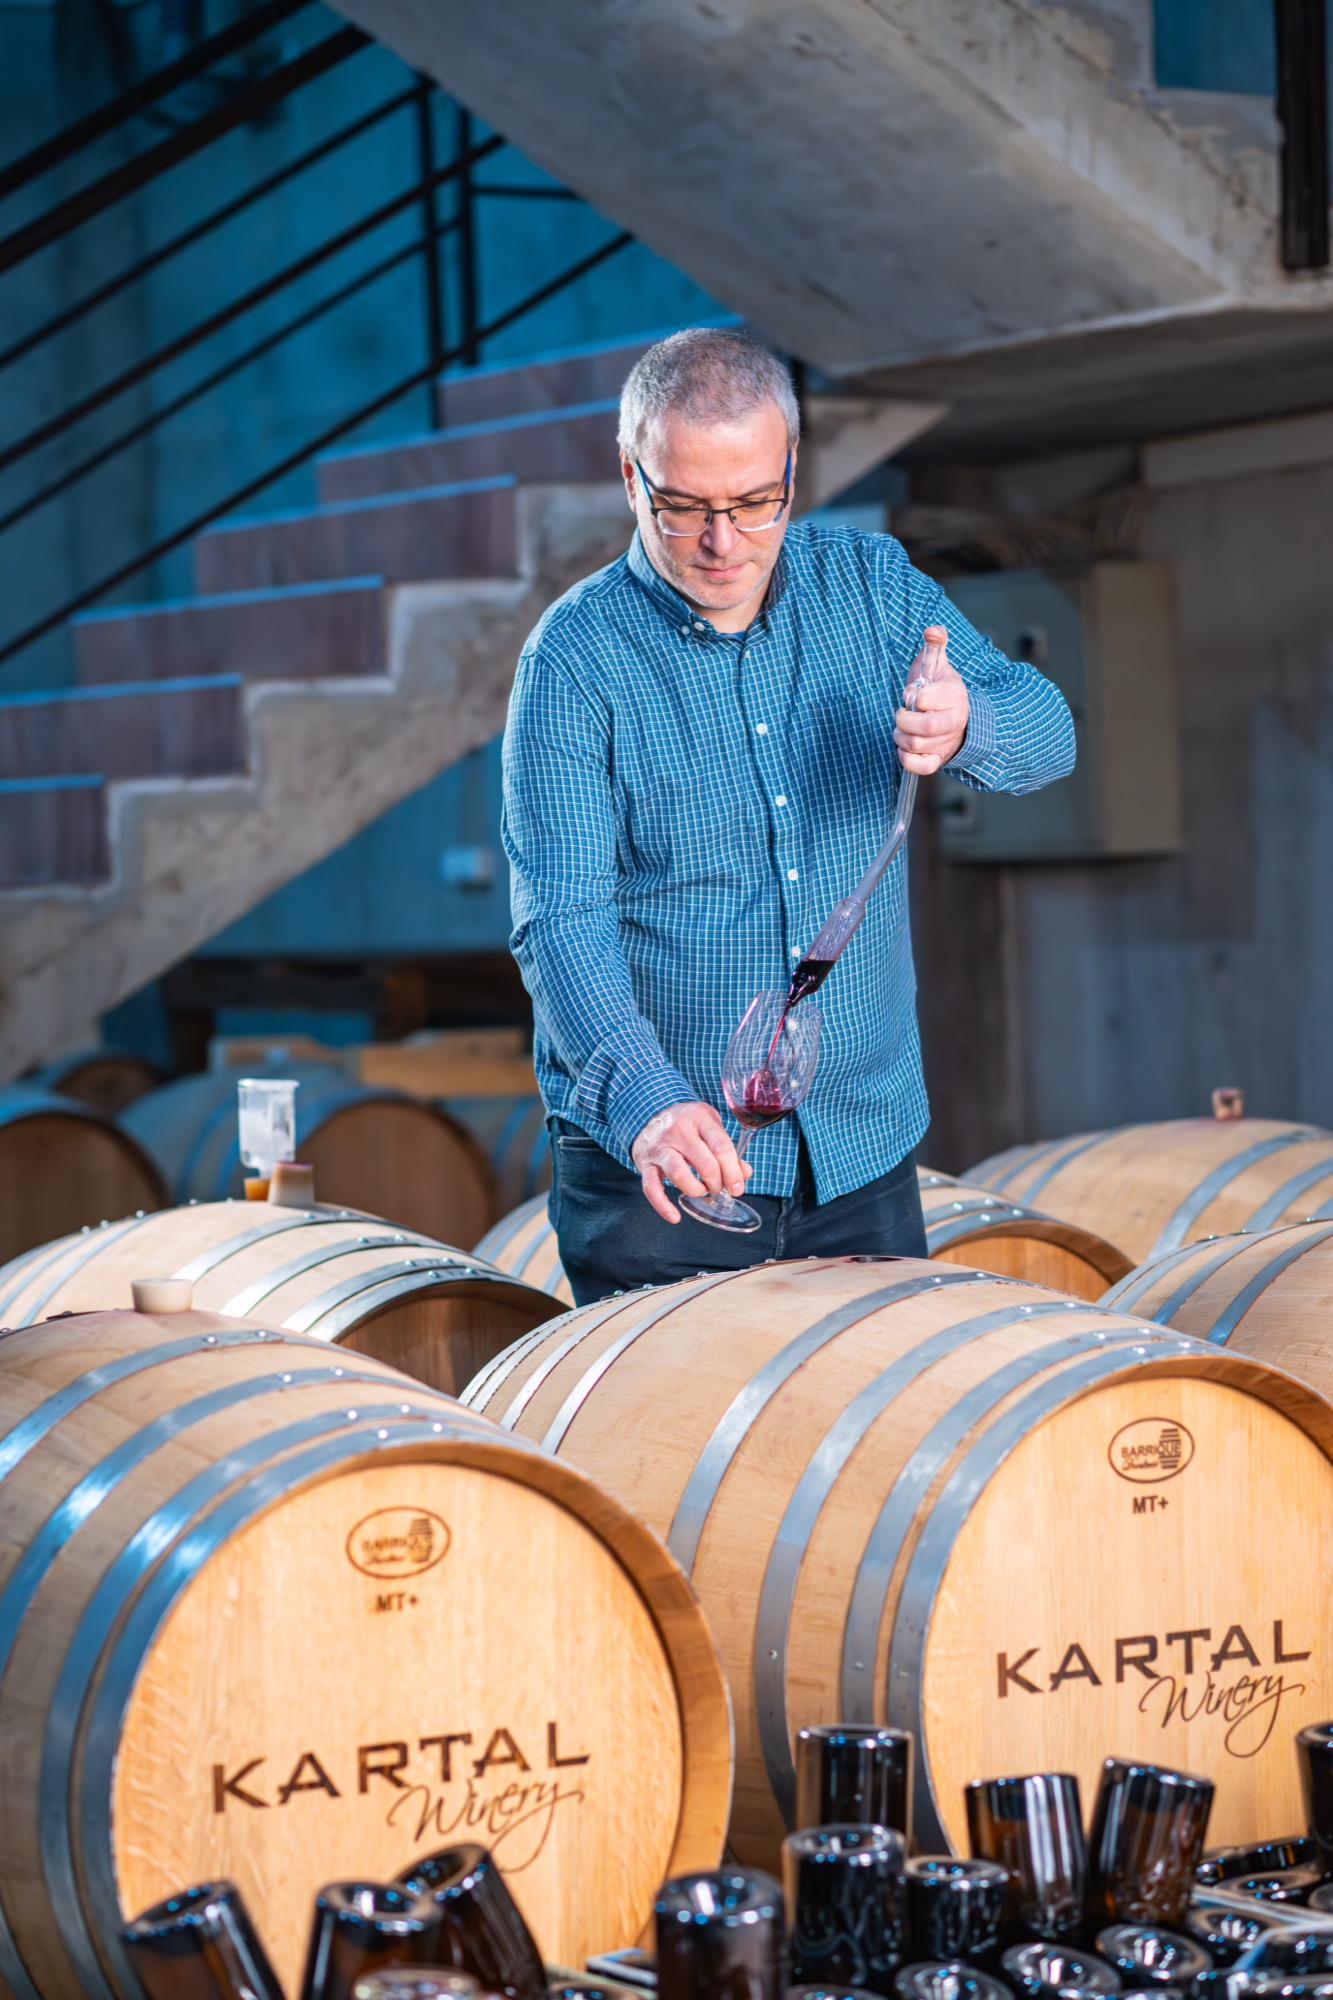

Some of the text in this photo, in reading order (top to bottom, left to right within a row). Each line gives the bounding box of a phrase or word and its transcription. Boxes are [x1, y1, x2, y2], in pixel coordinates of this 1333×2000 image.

[1121, 1440, 1181, 1458] BARRIQUE
[1132, 1494, 1169, 1514] MT+
[375, 1592, 418, 1614] MT+
[996, 1619, 1312, 1698] KARTAL
[1138, 1671, 1306, 1758] Winery
[212, 1721, 590, 1814] KARTAL
[386, 1778, 584, 1874] Winery
